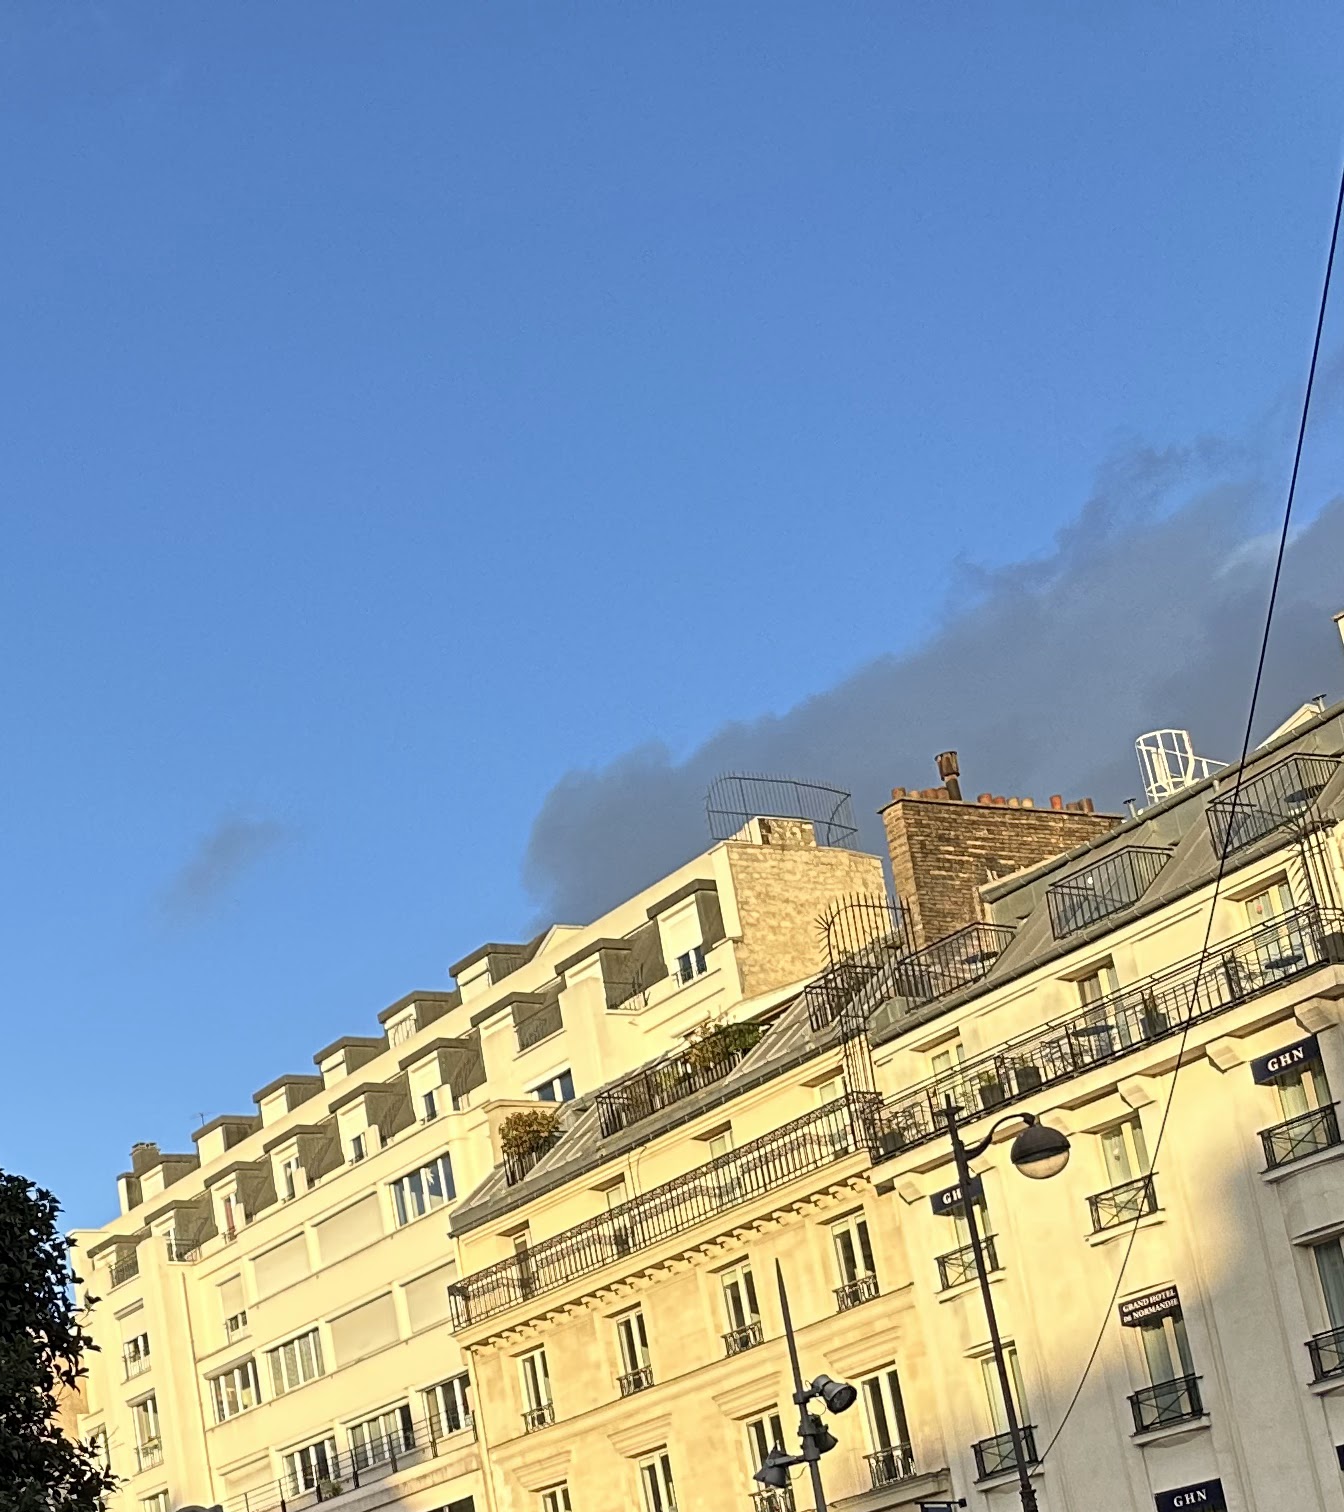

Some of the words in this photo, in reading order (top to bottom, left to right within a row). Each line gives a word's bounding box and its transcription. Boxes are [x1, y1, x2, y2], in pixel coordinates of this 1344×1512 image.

[1267, 1046, 1305, 1072] GHN
[942, 1187, 963, 1205] GH
[1122, 1297, 1149, 1313] GRAND
[1150, 1288, 1176, 1304] HOTEL
[1132, 1297, 1179, 1320] NORMANDIE
[1173, 1488, 1208, 1508] GHN
